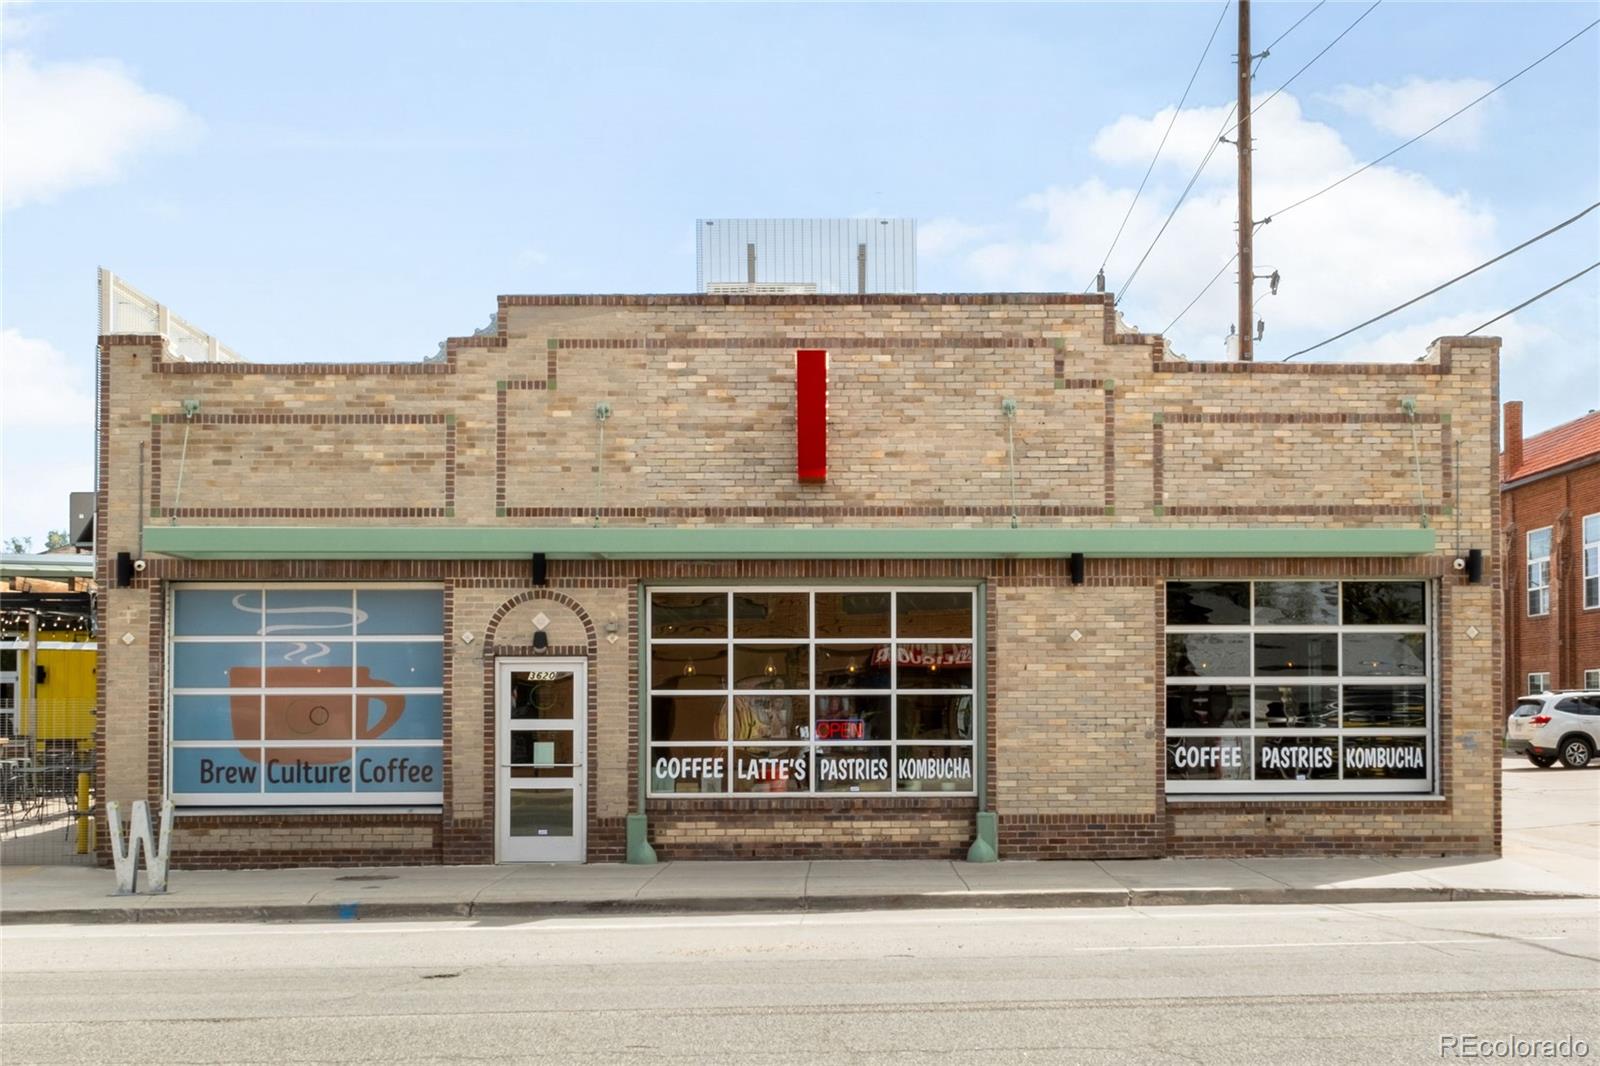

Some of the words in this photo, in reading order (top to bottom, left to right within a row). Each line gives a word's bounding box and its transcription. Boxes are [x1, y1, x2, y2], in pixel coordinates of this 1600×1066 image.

[528, 672, 556, 681] 3620
[817, 722, 863, 739] OPEN
[655, 756, 724, 780] COFFEE
[738, 757, 806, 781] LATTE'S
[820, 757, 888, 781] PASTRIES
[898, 757, 972, 780] KOMBUCHA
[1174, 746, 1242, 768] COFFEE
[1261, 746, 1333, 769] PASTRIES
[1346, 746, 1424, 769] KOMBUCHA
[200, 758, 257, 784] Brew
[267, 758, 351, 785] Culture
[359, 757, 434, 784] Coffee
[106, 799, 174, 894] W
